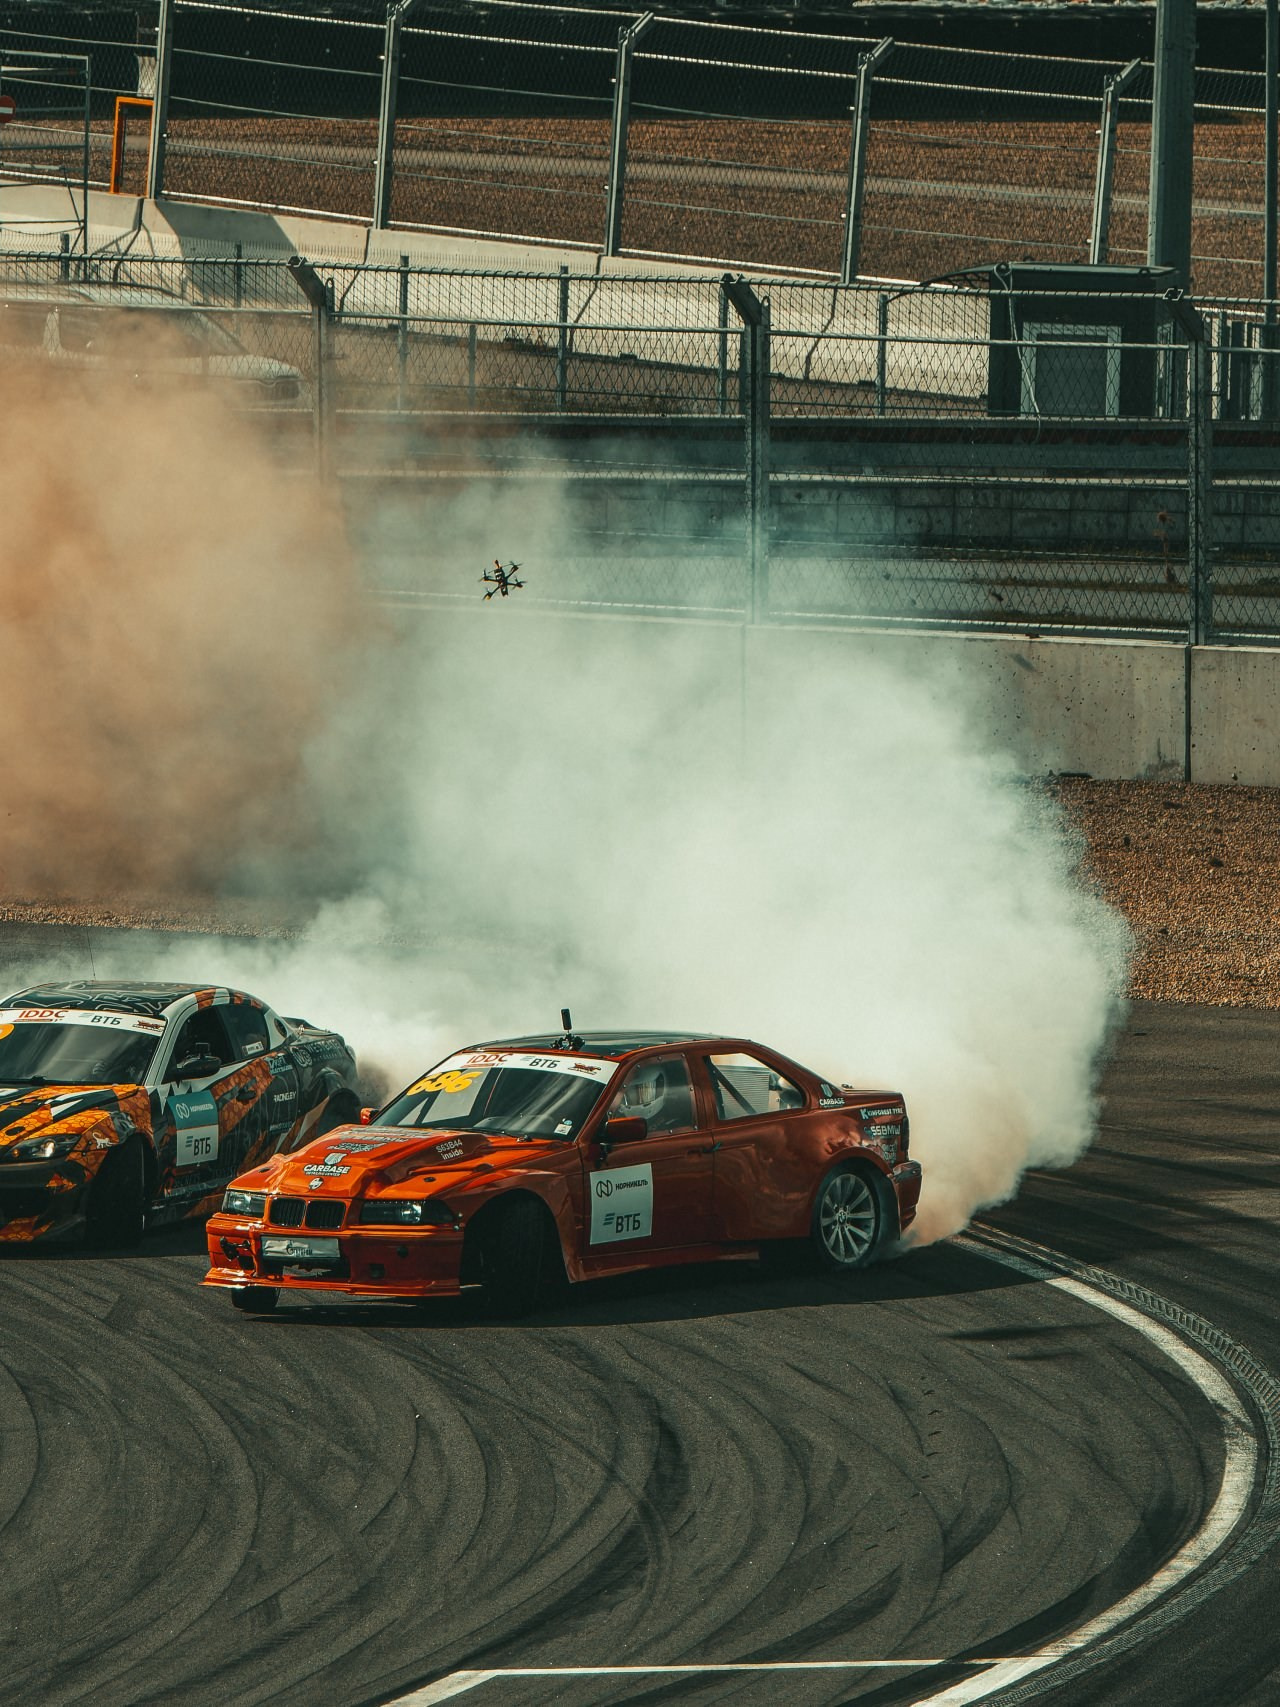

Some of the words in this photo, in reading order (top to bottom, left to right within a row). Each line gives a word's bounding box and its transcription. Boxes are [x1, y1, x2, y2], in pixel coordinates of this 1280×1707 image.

[18, 1010, 69, 1019] IDDC
[90, 1015, 123, 1026] ВТБ
[467, 1053, 514, 1064] IDDC
[528, 1057, 561, 1069] ВТБ
[407, 1069, 483, 1096] 686
[819, 1098, 845, 1106] CARBASE
[193, 1136, 211, 1156] ВТБ
[441, 1148, 464, 1161] inside
[303, 1163, 351, 1175] CARBASE
[615, 1179, 649, 1190] НОРНИКЕЛЬ
[615, 1212, 641, 1233] ВТБ
